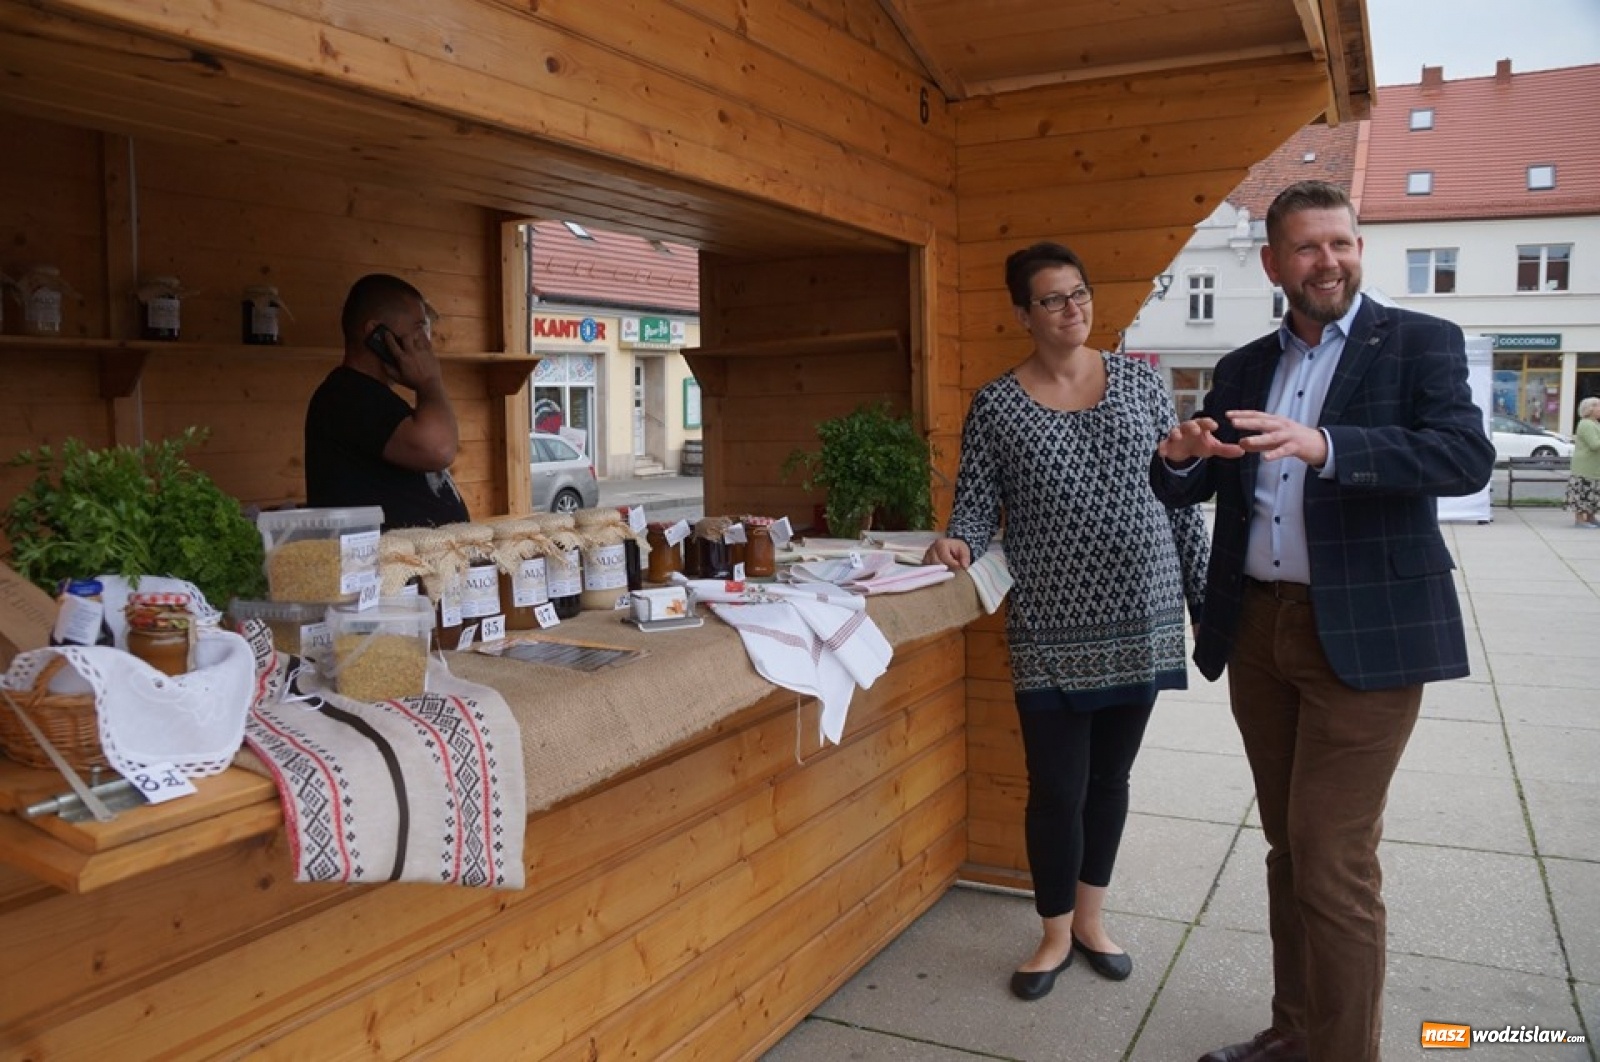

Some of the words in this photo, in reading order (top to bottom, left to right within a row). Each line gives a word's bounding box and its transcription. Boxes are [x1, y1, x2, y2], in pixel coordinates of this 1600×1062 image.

[919, 87, 929, 124] 6
[534, 317, 606, 343] KANTOR
[484, 621, 499, 636] 35
